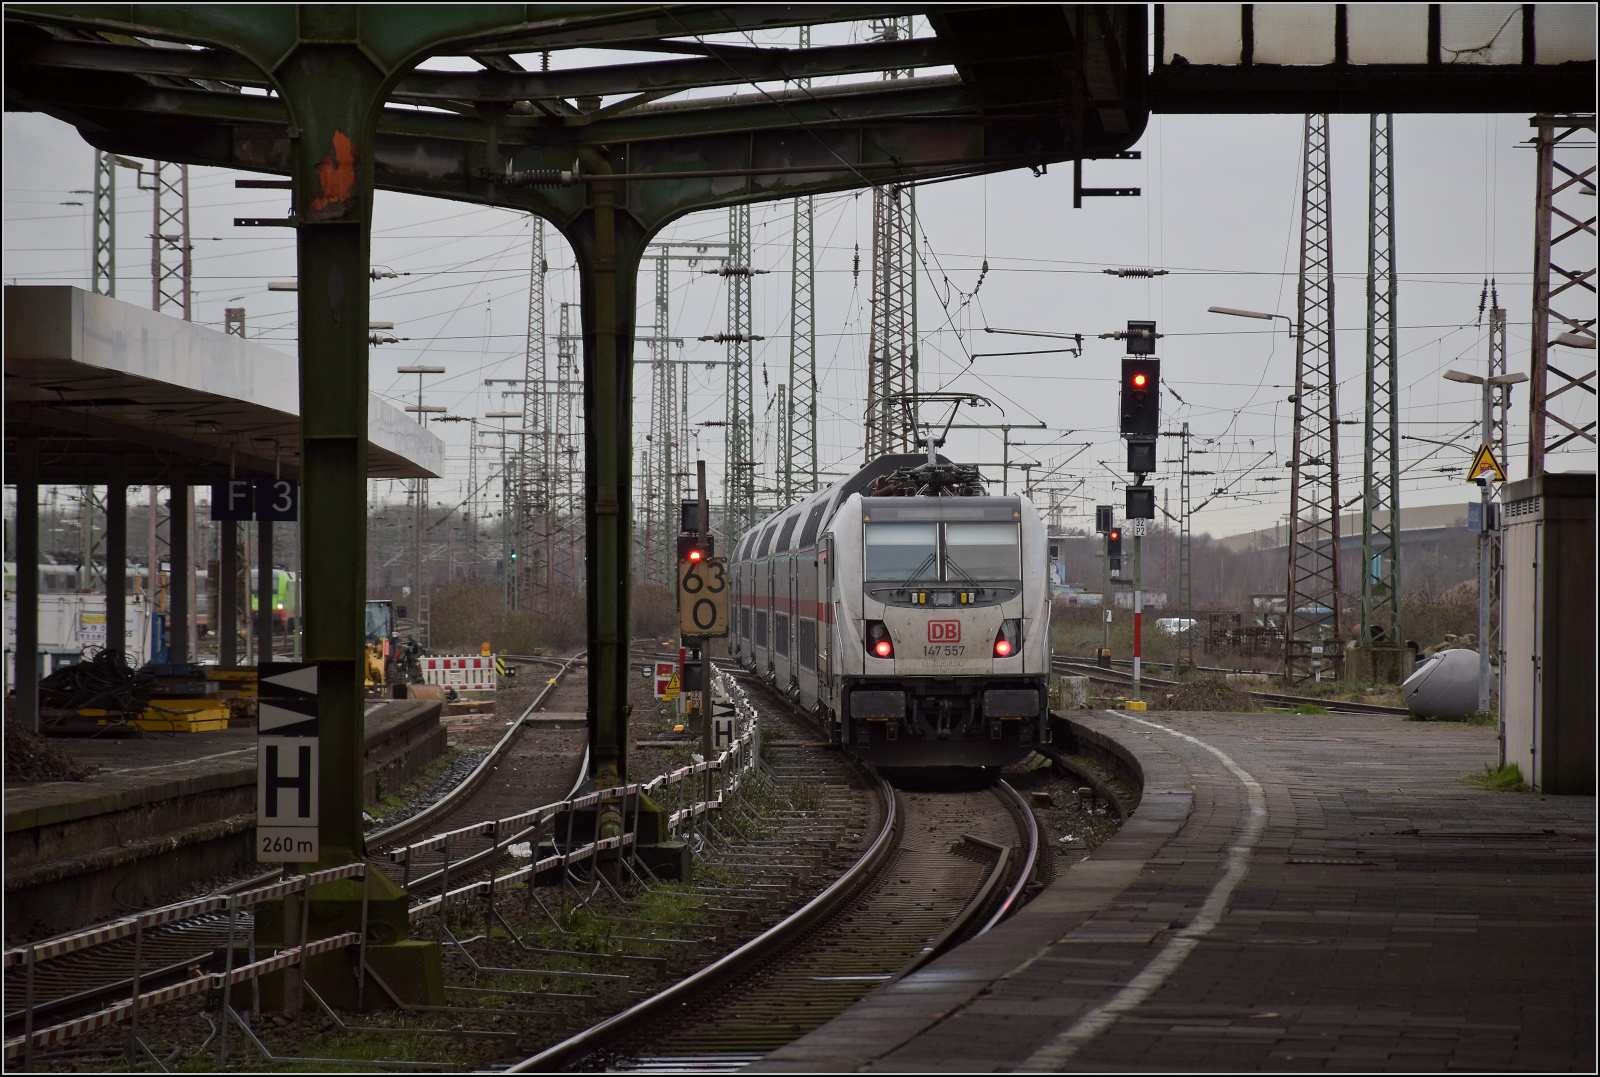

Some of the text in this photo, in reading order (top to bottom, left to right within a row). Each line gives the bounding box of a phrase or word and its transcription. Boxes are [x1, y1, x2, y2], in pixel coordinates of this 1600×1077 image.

[228, 480, 248, 511] F
[271, 480, 293, 512] 3
[1135, 518, 1145, 527] 32
[1136, 527, 1145, 536] P2
[682, 560, 726, 594] 63
[692, 598, 717, 630] 0
[931, 623, 958, 640] DB
[923, 645, 966, 657] 147 557
[691, 699, 701, 708] P3
[715, 720, 733, 747] H
[265, 745, 311, 818] H
[262, 837, 313, 853] 260 m
